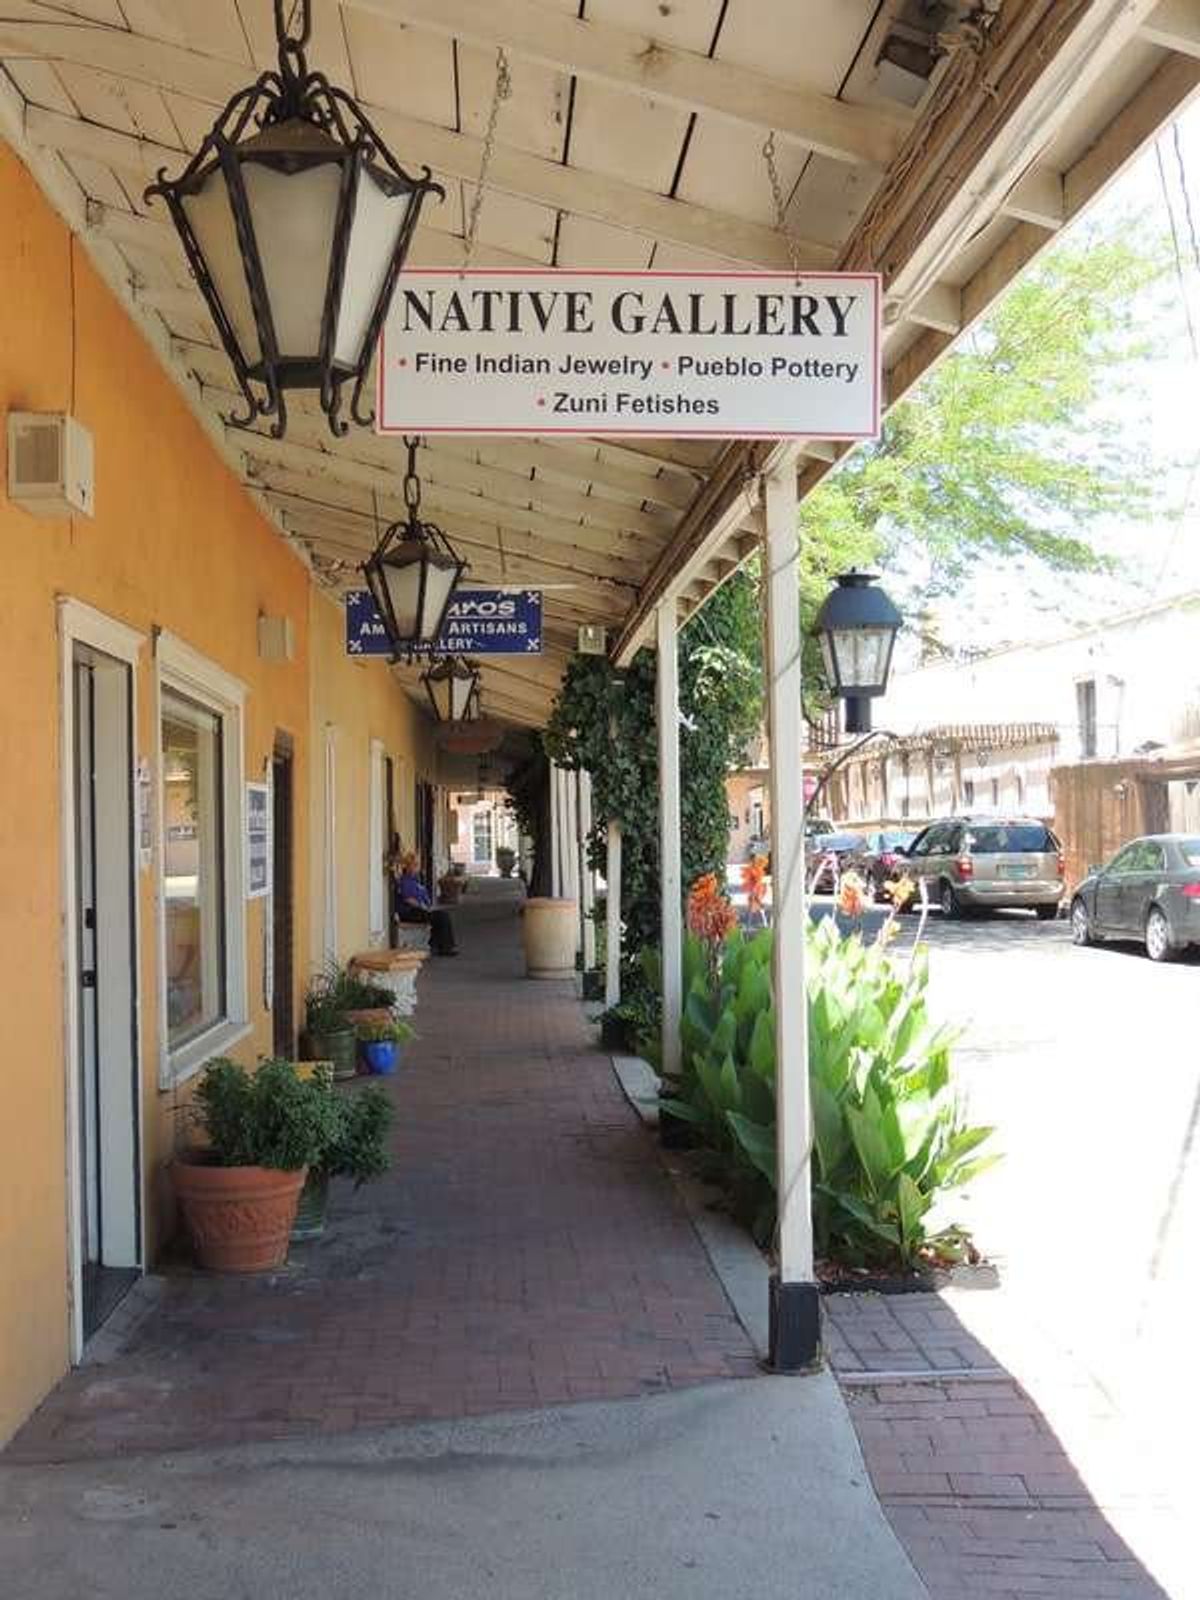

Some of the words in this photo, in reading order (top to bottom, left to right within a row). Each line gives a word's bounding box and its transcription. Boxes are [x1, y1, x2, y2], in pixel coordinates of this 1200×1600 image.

[402, 289, 594, 334] NATIVE
[611, 292, 857, 338] GALLERY
[415, 352, 467, 374] Fine
[475, 353, 551, 375] Indian
[558, 354, 653, 381] Jewelry
[678, 355, 763, 378] Pueblo
[771, 357, 859, 383] Pottery
[553, 392, 607, 414] Zuni
[616, 393, 720, 416] Fetishes
[448, 620, 528, 636] ARTISANS
